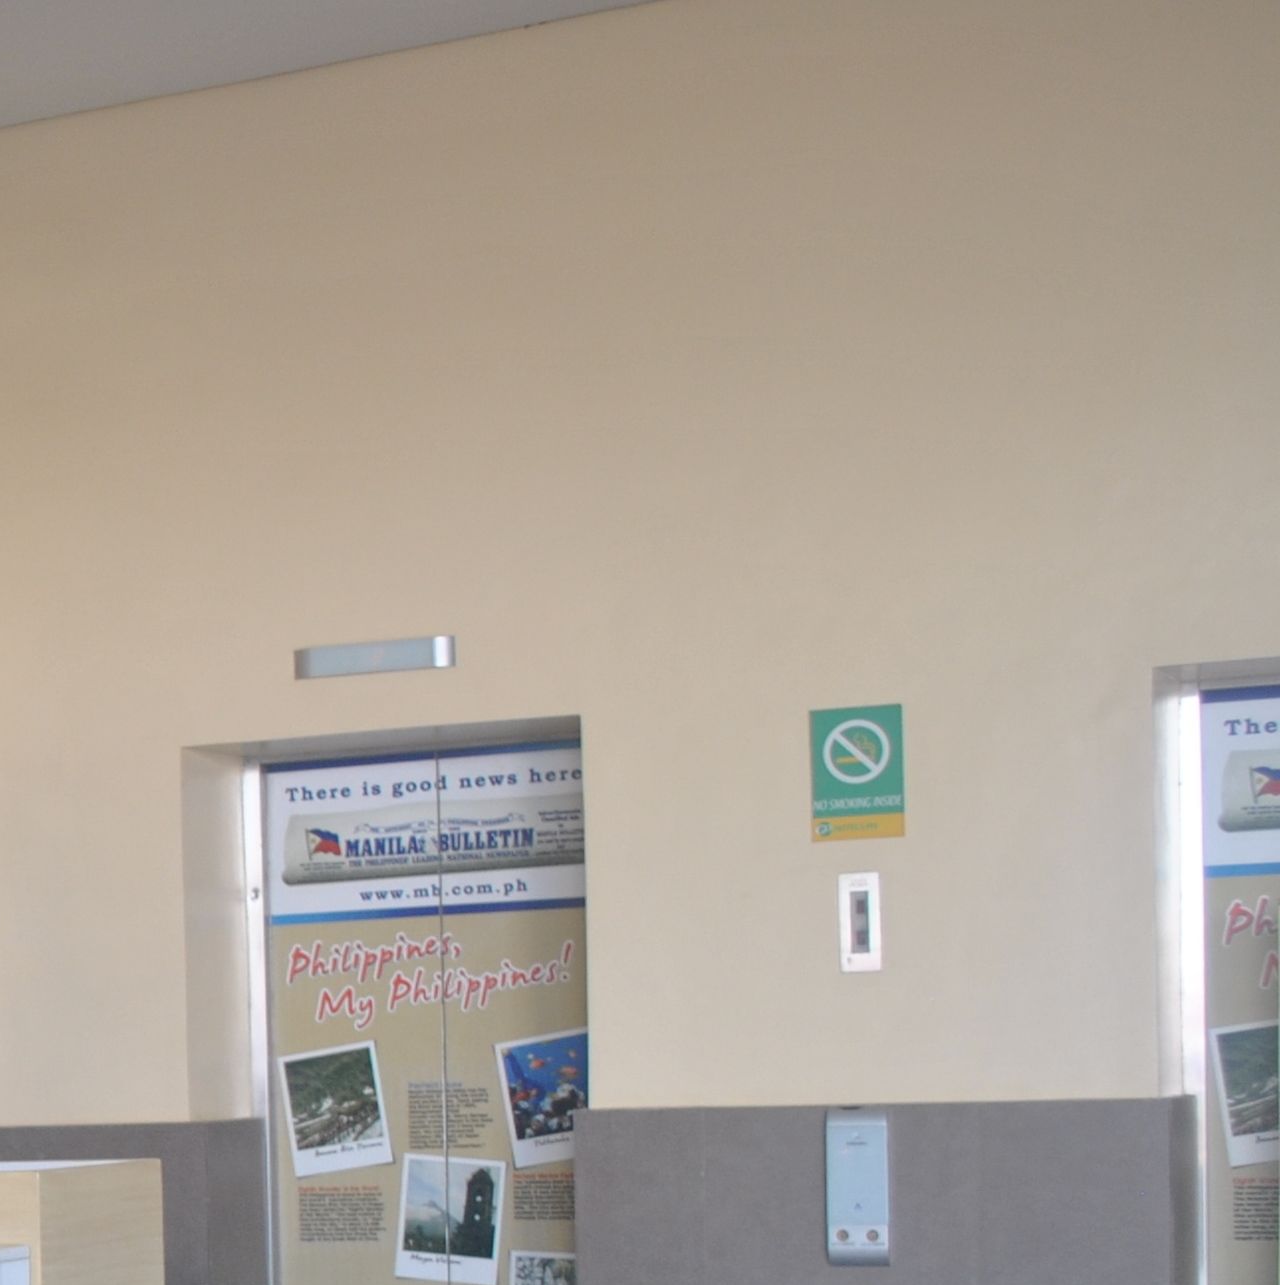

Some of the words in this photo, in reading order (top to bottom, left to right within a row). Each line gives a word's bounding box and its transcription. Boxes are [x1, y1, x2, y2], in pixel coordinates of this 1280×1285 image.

[285, 786, 351, 802] There
[362, 781, 382, 796] is
[392, 776, 448, 798] good
[459, 773, 518, 789] news
[530, 768, 582, 783] here
[829, 796, 872, 810] SMOKING
[345, 836, 419, 858] MANILA
[439, 828, 534, 852] BULLETIN
[359, 879, 529, 902] www.mb.com.ph
[288, 933, 463, 983] Philippines,
[318, 988, 374, 1029] My
[391, 943, 575, 1009] Philippines!
